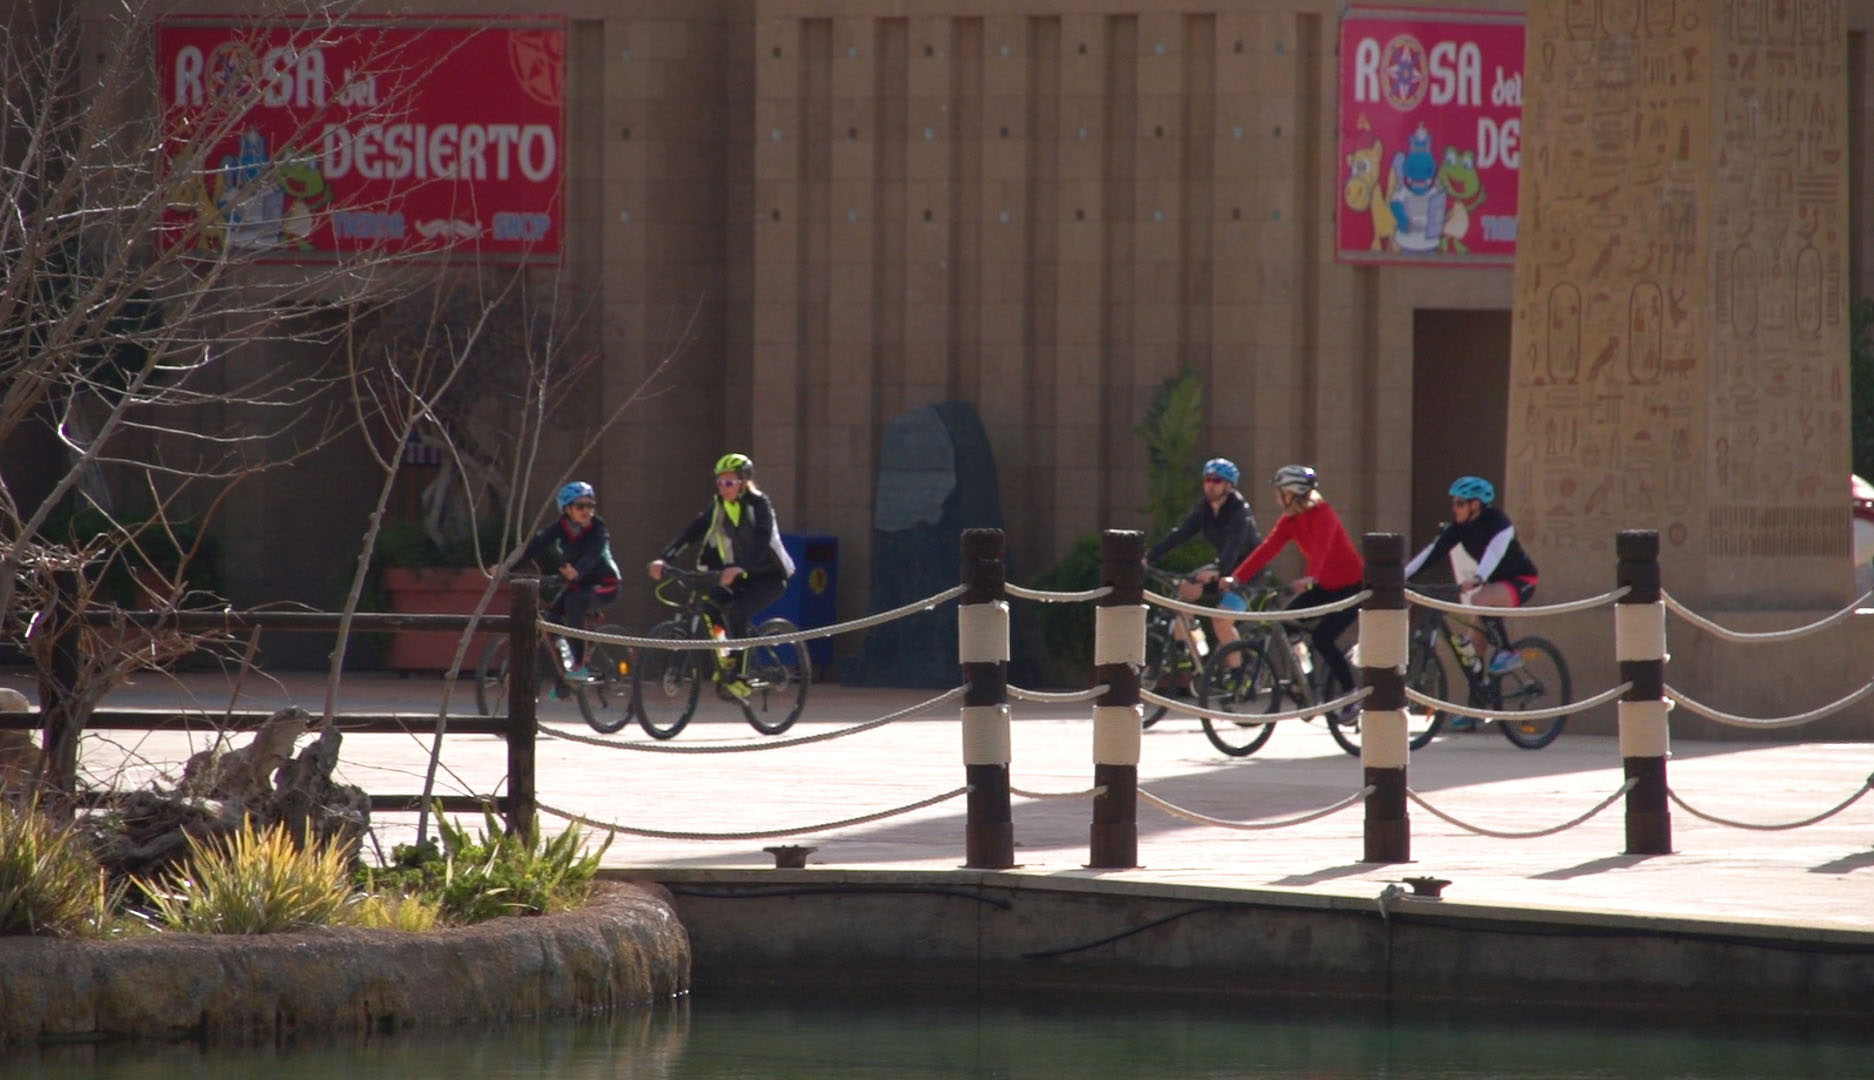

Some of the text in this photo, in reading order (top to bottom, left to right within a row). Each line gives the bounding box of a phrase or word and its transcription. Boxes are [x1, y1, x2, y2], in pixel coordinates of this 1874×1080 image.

[175, 42, 326, 108] ROSA
[1355, 34, 1482, 111] ROSA
[323, 124, 556, 182] DESIERTO
